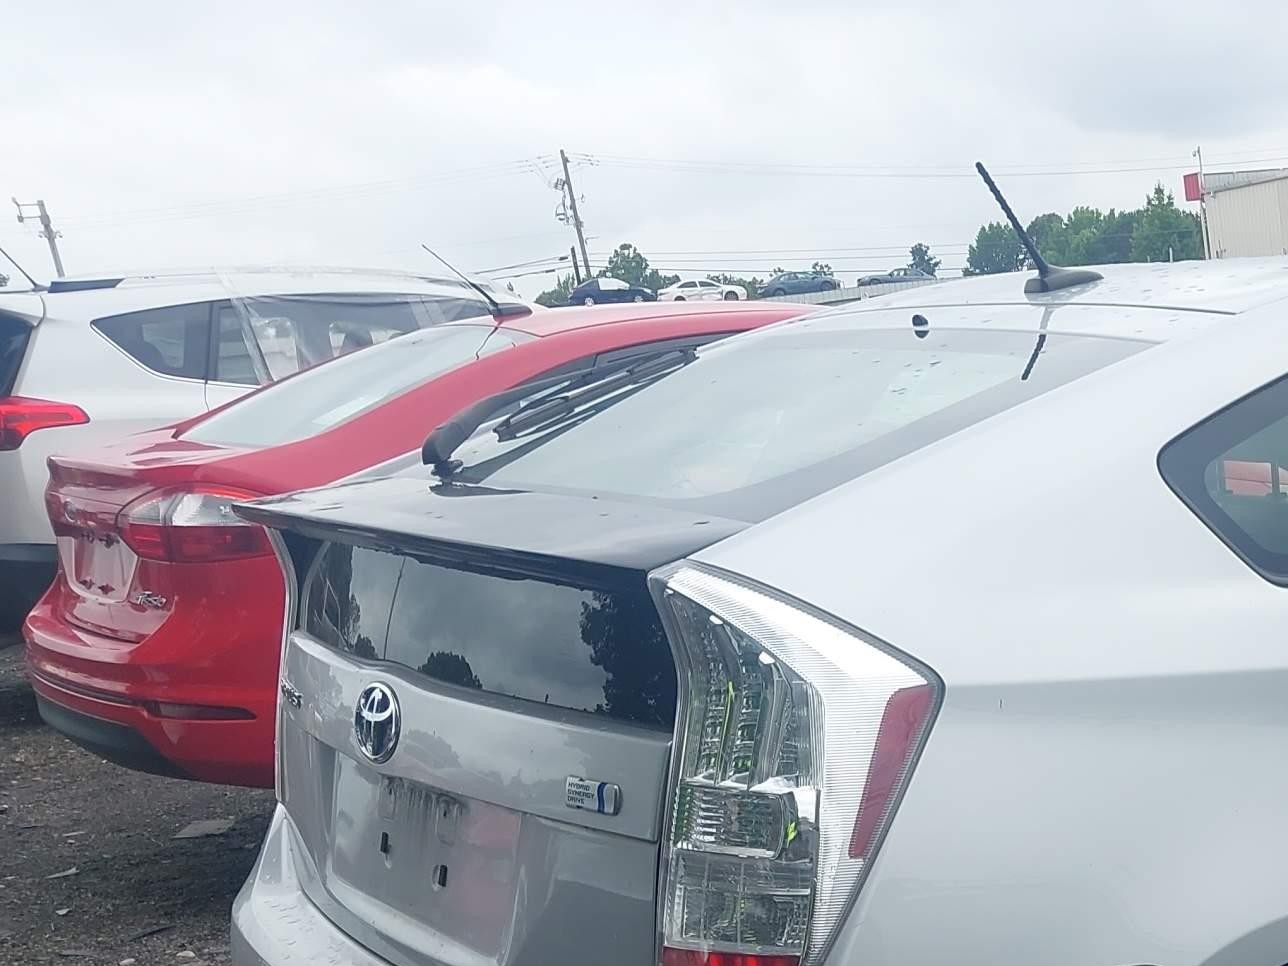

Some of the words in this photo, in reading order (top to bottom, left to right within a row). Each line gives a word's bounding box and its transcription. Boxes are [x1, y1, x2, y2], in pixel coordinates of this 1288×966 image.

[568, 782, 591, 791] HYBRID
[567, 788, 595, 800] SYNERGY
[567, 795, 585, 805] DRIVE
